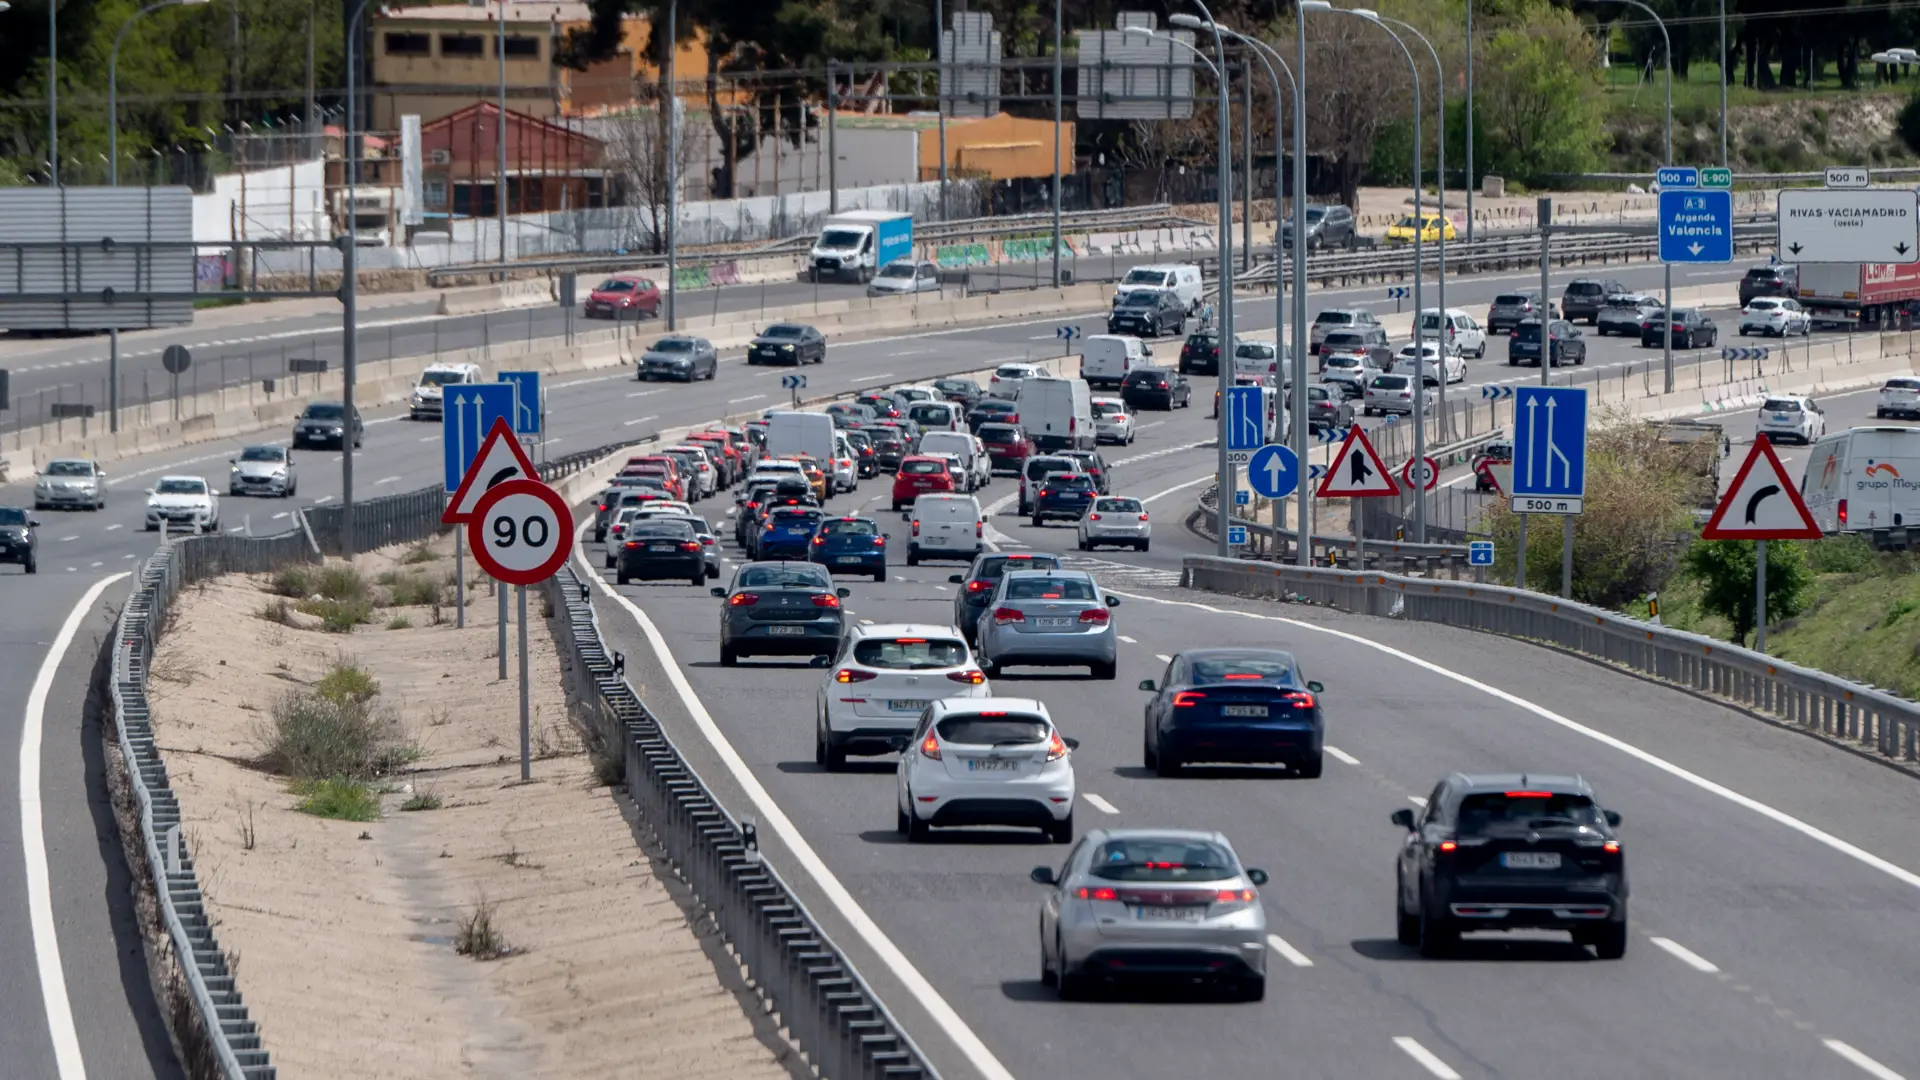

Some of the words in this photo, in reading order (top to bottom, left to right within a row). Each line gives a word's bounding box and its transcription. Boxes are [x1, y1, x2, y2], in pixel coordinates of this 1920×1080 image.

[1660, 173, 1680, 182] 500
[1685, 175, 1695, 183] m
[1702, 174, 1729, 182] E-901
[1829, 173, 1850, 182] 500
[1790, 208, 1907, 217] RIVAS-VACIAMADRID
[1675, 212, 1716, 224] Arganda
[1668, 225, 1722, 236] Valencia
[1228, 453, 1248, 462] 300
[1857, 480, 1889, 491] grupo
[1526, 500, 1552, 510] 500
[1556, 502, 1568, 511] m
[493, 515, 549, 548] 90
[1478, 552, 1485, 561] 4
